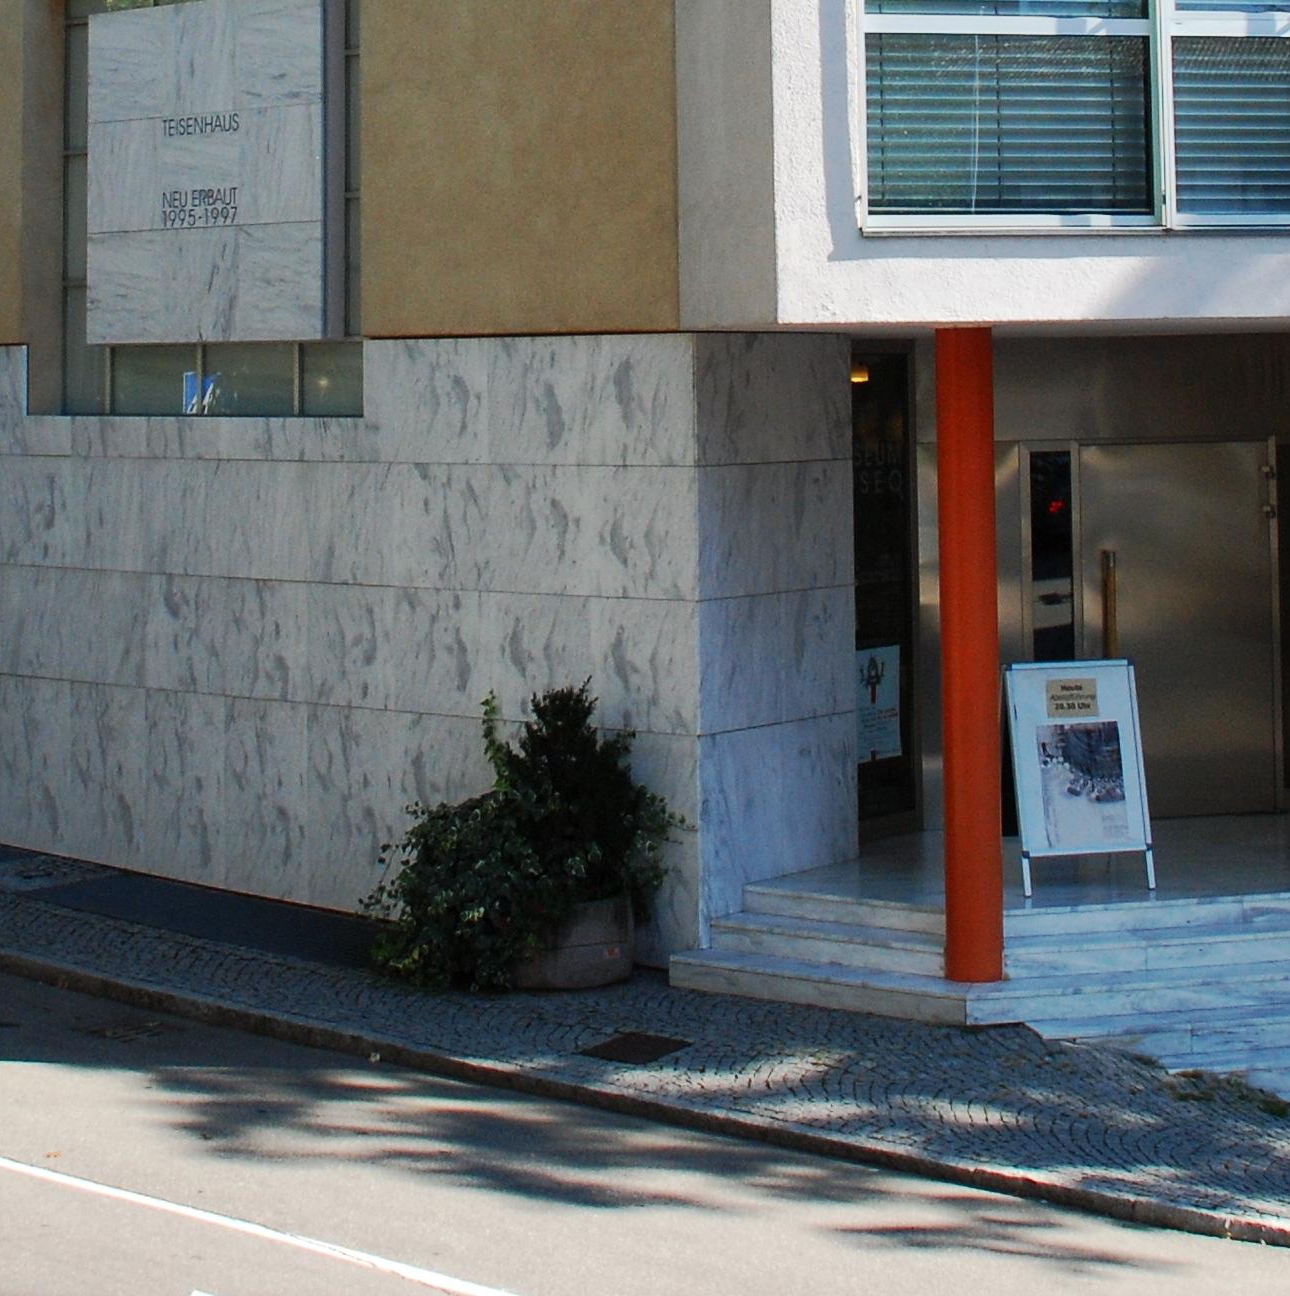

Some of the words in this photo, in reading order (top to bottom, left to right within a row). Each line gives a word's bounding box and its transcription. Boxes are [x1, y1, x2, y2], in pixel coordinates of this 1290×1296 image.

[162, 113, 240, 137] TEISENHAUS
[162, 191, 188, 209] NEU
[191, 187, 238, 207] ERBAUT
[162, 206, 238, 227] 1995-1997
